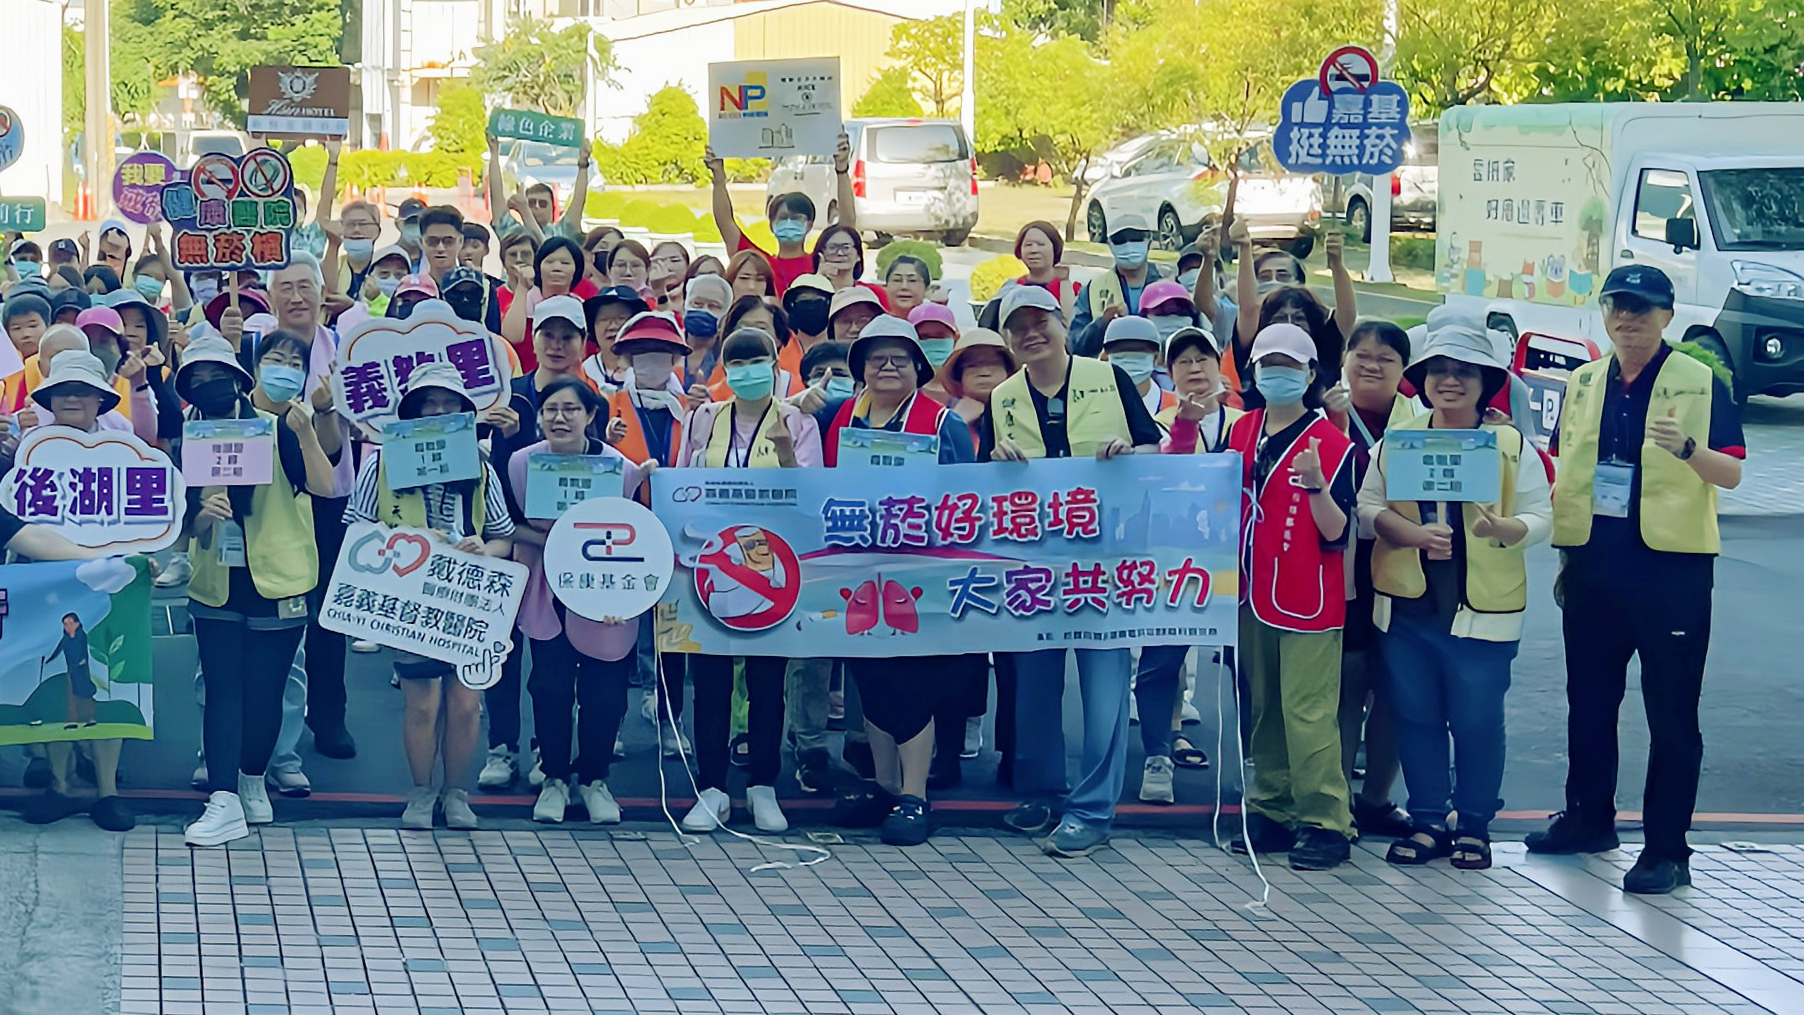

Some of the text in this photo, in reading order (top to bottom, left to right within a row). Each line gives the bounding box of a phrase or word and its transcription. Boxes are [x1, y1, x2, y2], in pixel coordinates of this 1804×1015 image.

[719, 84, 766, 112] NP
[1331, 94, 1401, 123] 嘉基
[1288, 126, 1399, 165] 挺無菸
[13, 466, 170, 517] 後湖里
[821, 486, 1101, 549] 無菸好環境
[947, 557, 1214, 619] 大家共努力
[332, 582, 490, 643] 嘉義基督教醫院
[428, 635, 480, 658] HOSPITAL
